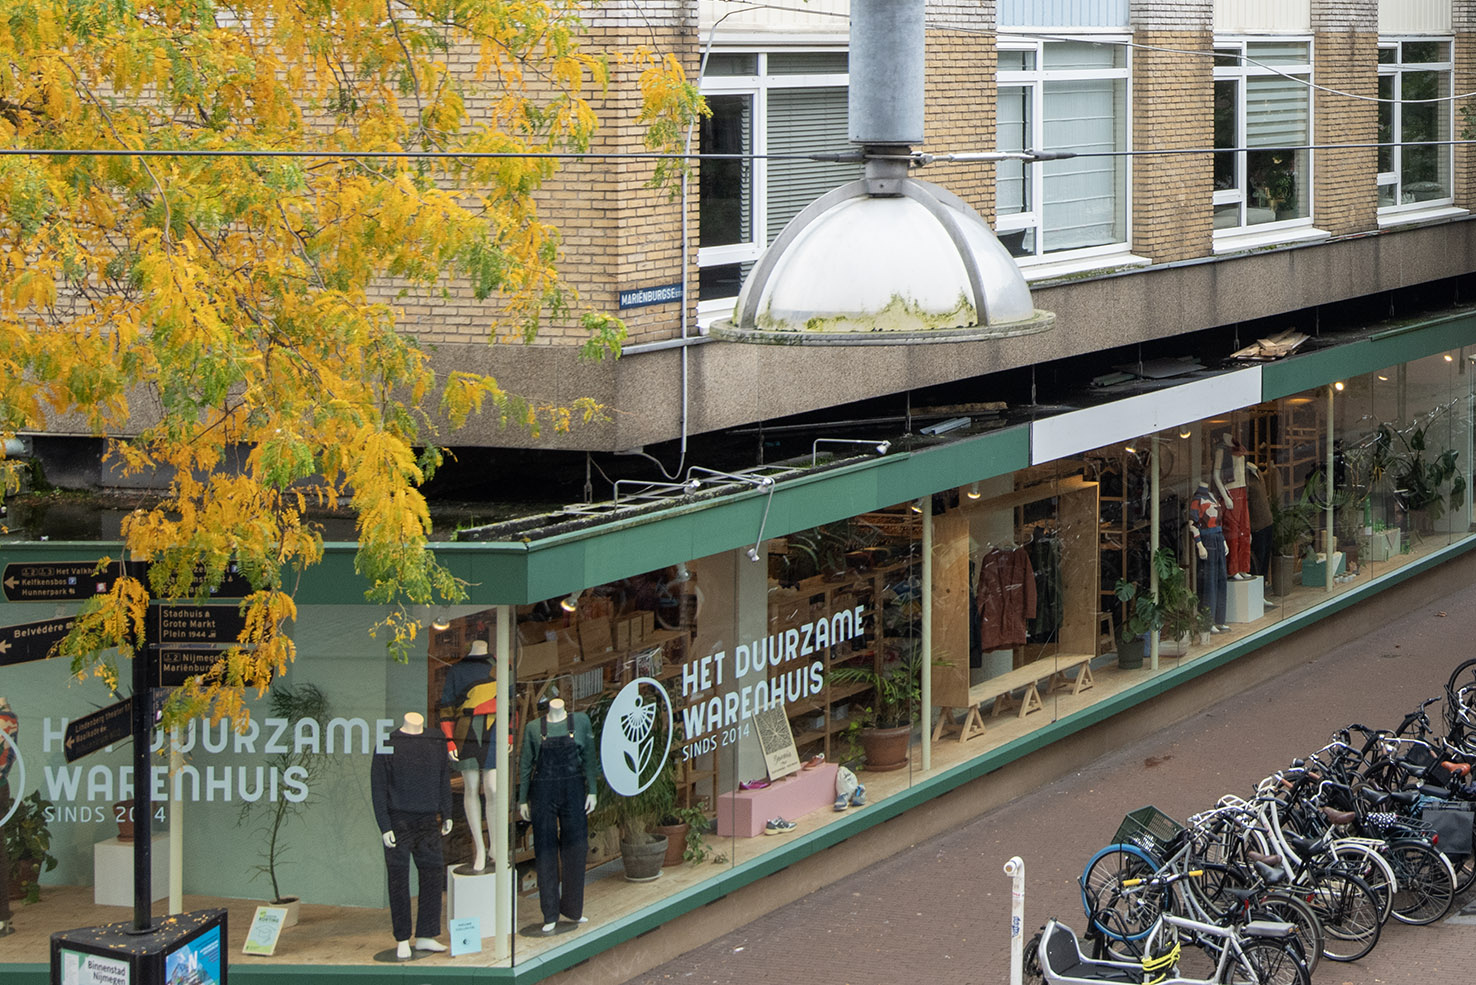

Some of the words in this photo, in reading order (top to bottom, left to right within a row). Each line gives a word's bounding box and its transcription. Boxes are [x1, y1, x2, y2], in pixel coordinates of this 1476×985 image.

[22, 578, 67, 586] Kelfkensbos
[163, 610, 203, 618] Stadhuis
[14, 623, 63, 638] Belvédère
[163, 620, 187, 628] Grote
[190, 620, 216, 628] Markt
[163, 630, 186, 638] Plein
[682, 651, 726, 697] HET
[735, 605, 865, 679] DUURZAME
[682, 661, 824, 740] WARENHUIS
[682, 734, 718, 762] SINDS
[721, 722, 751, 747] 2014
[44, 805, 105, 823] SINDS
[115, 805, 166, 823] 204
[88, 960, 126, 976] Binnenstad
[93, 971, 126, 985] Nijmegen
